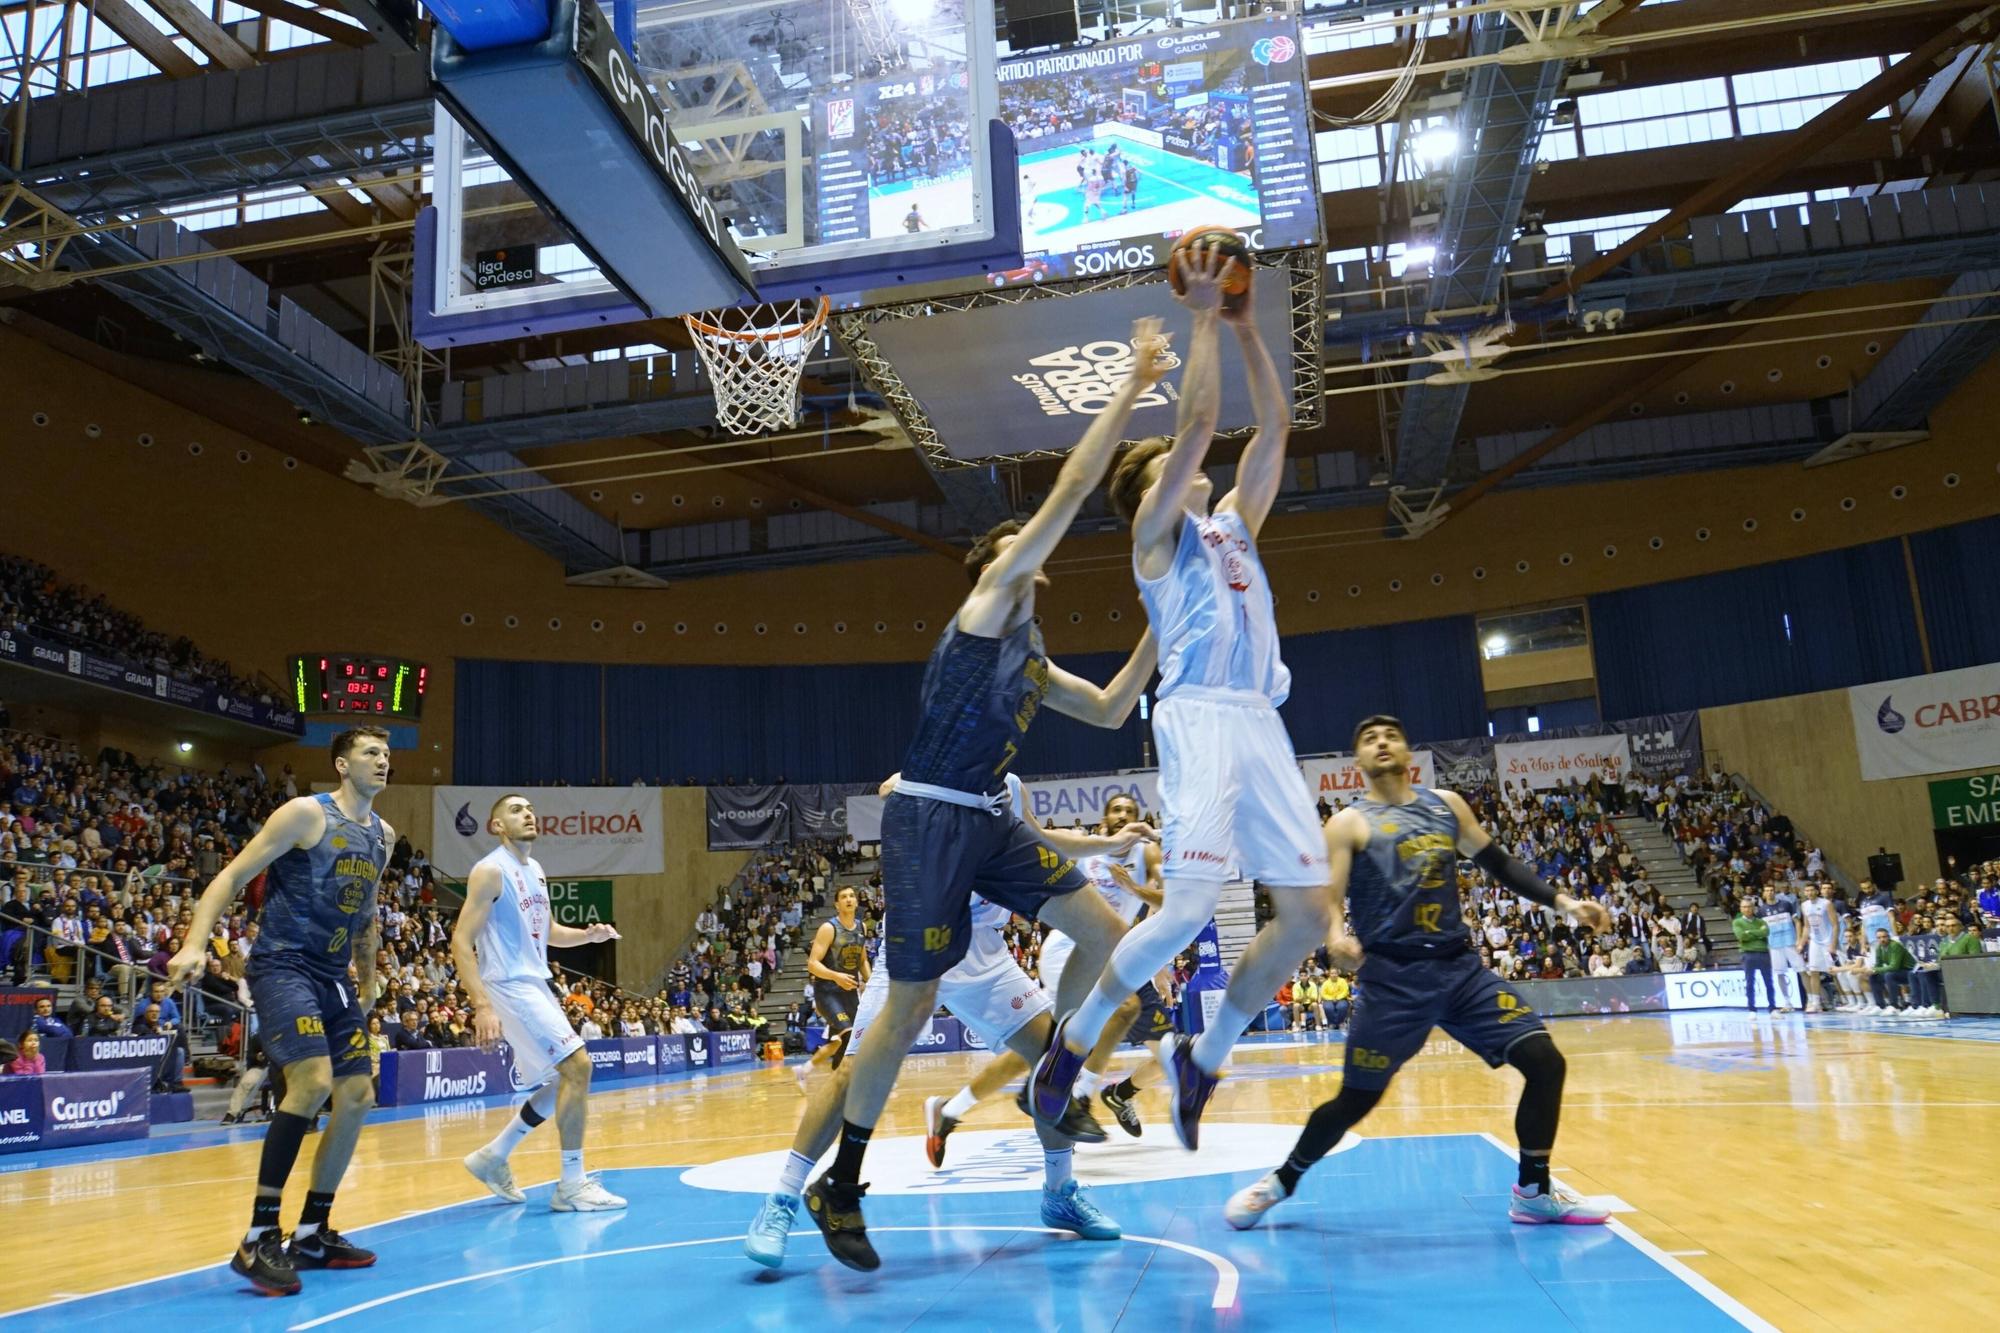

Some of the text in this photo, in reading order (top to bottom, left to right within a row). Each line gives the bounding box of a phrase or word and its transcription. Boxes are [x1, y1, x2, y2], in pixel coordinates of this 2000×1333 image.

[1174, 31, 1221, 45] LEXUS
[1174, 43, 1208, 54] GALICIA
[1036, 47, 1116, 76] PATROCINADO
[1118, 43, 1143, 63] POR
[608, 48, 721, 248] endesa
[478, 261, 503, 275] liga
[1074, 244, 1155, 277] SOMOS
[478, 269, 533, 286] endesa
[32, 646, 66, 664] GRADA
[124, 671, 154, 687] GRADA
[345, 664, 354, 676] 9
[377, 666, 387, 678] 12
[1319, 771, 1366, 792] ALZA
[486, 808, 644, 836] CREIROÁ
[717, 808, 782, 820] MOONOFF
[550, 882, 579, 901] DE
[92, 1037, 167, 1061] OBRADOIRO
